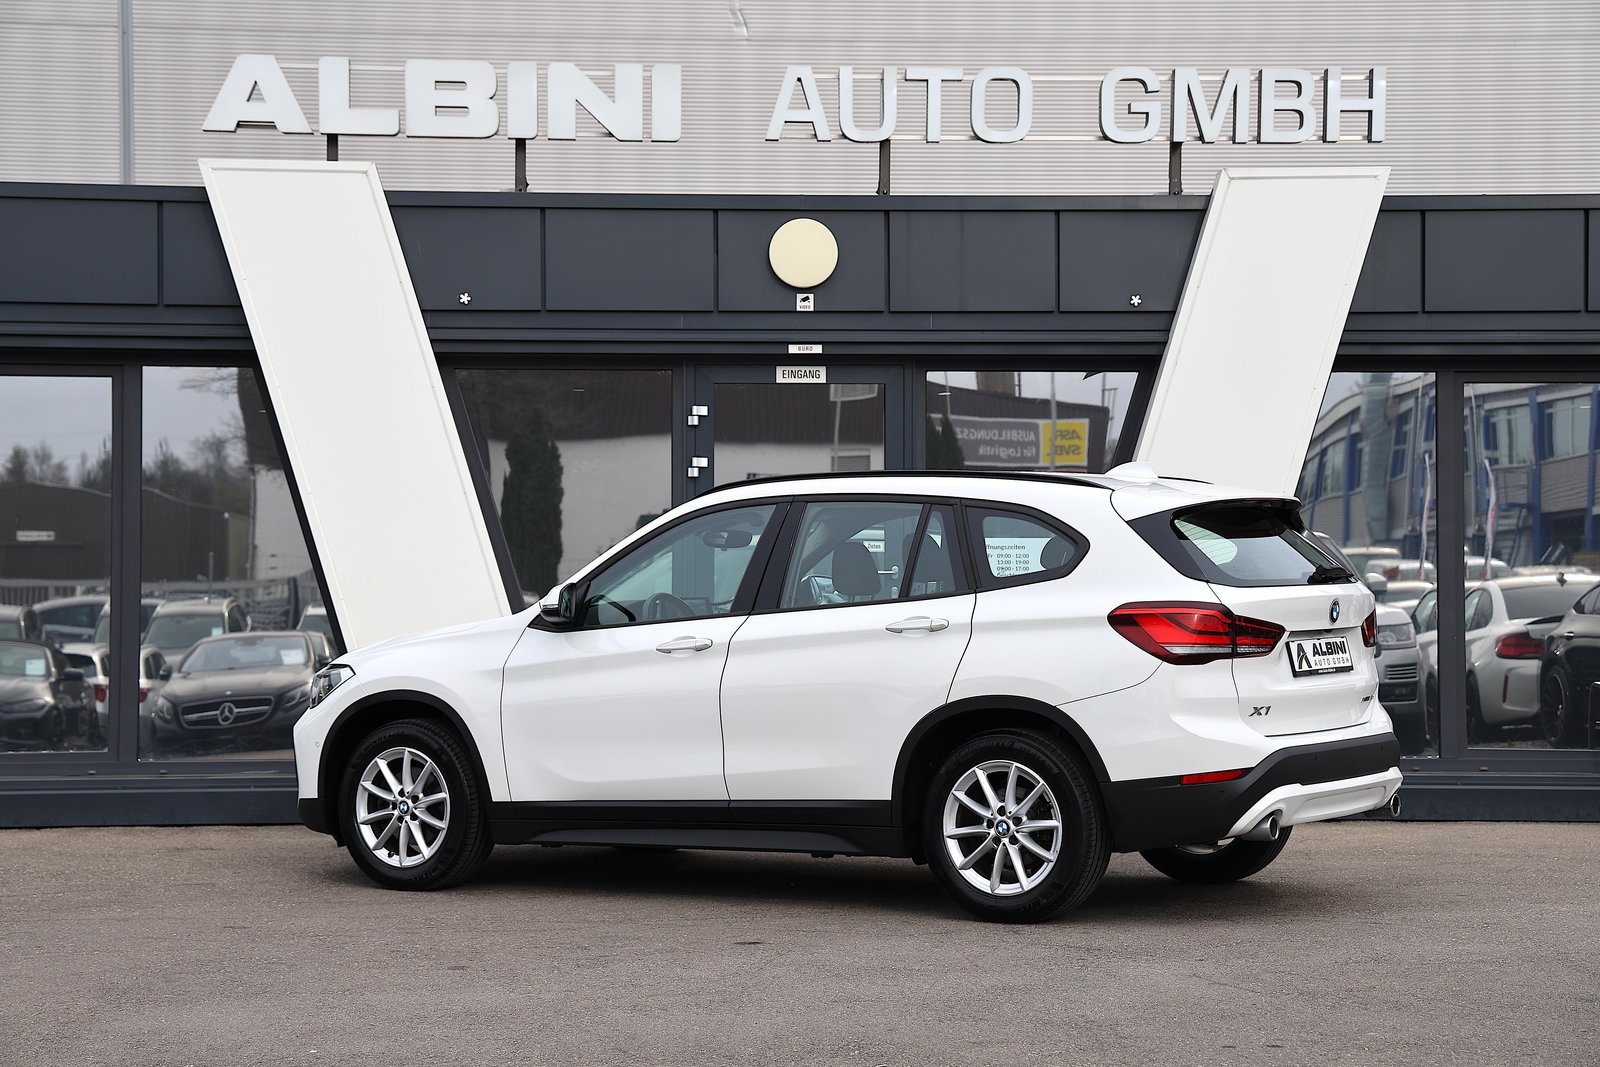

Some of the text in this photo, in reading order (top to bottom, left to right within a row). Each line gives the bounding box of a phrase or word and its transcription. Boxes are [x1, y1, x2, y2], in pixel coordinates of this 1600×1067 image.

[202, 53, 1388, 145] ALBINI AUTO GMBH
[782, 370, 820, 379] EINGANG
[1312, 640, 1347, 657] ALBINI
[1314, 656, 1350, 667] AUTO GMBH
[1248, 706, 1272, 716] X1
